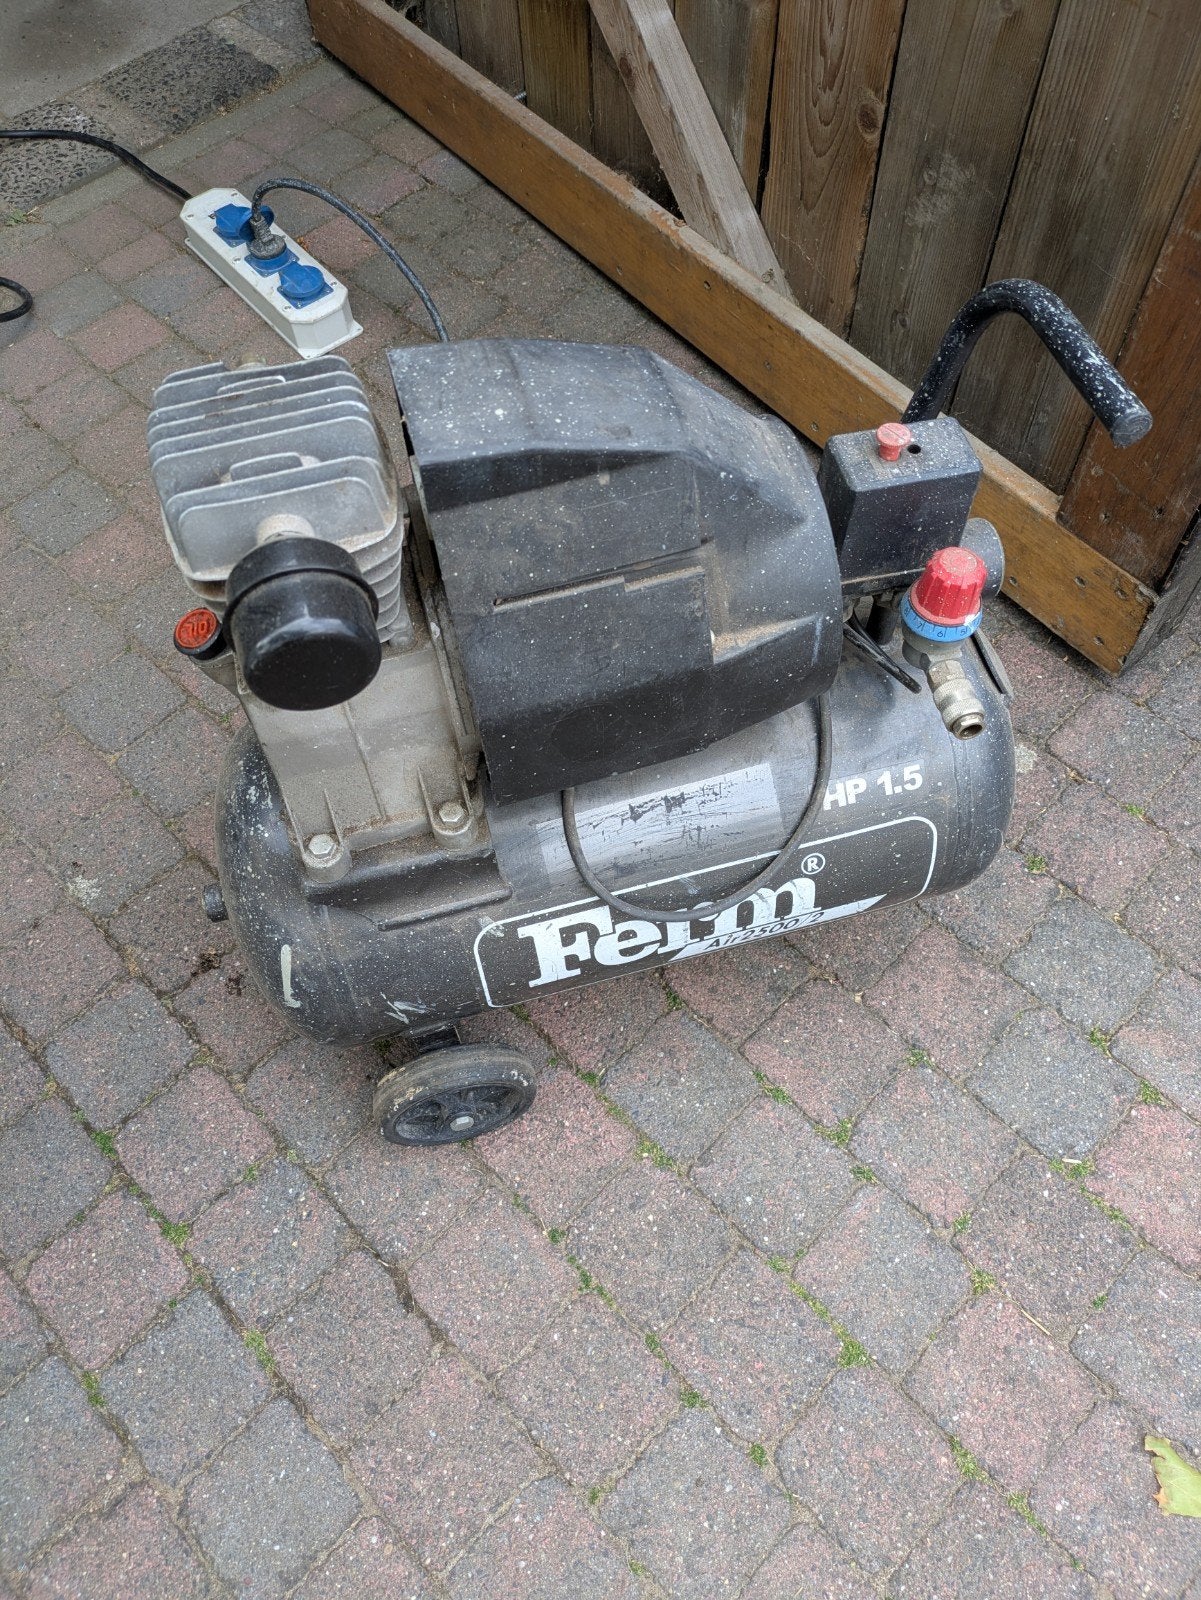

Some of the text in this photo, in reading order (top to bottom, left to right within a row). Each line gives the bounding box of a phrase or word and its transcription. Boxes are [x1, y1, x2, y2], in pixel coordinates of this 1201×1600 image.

[823, 764, 923, 810] HP 1.5
[516, 877, 822, 987] Ferm
